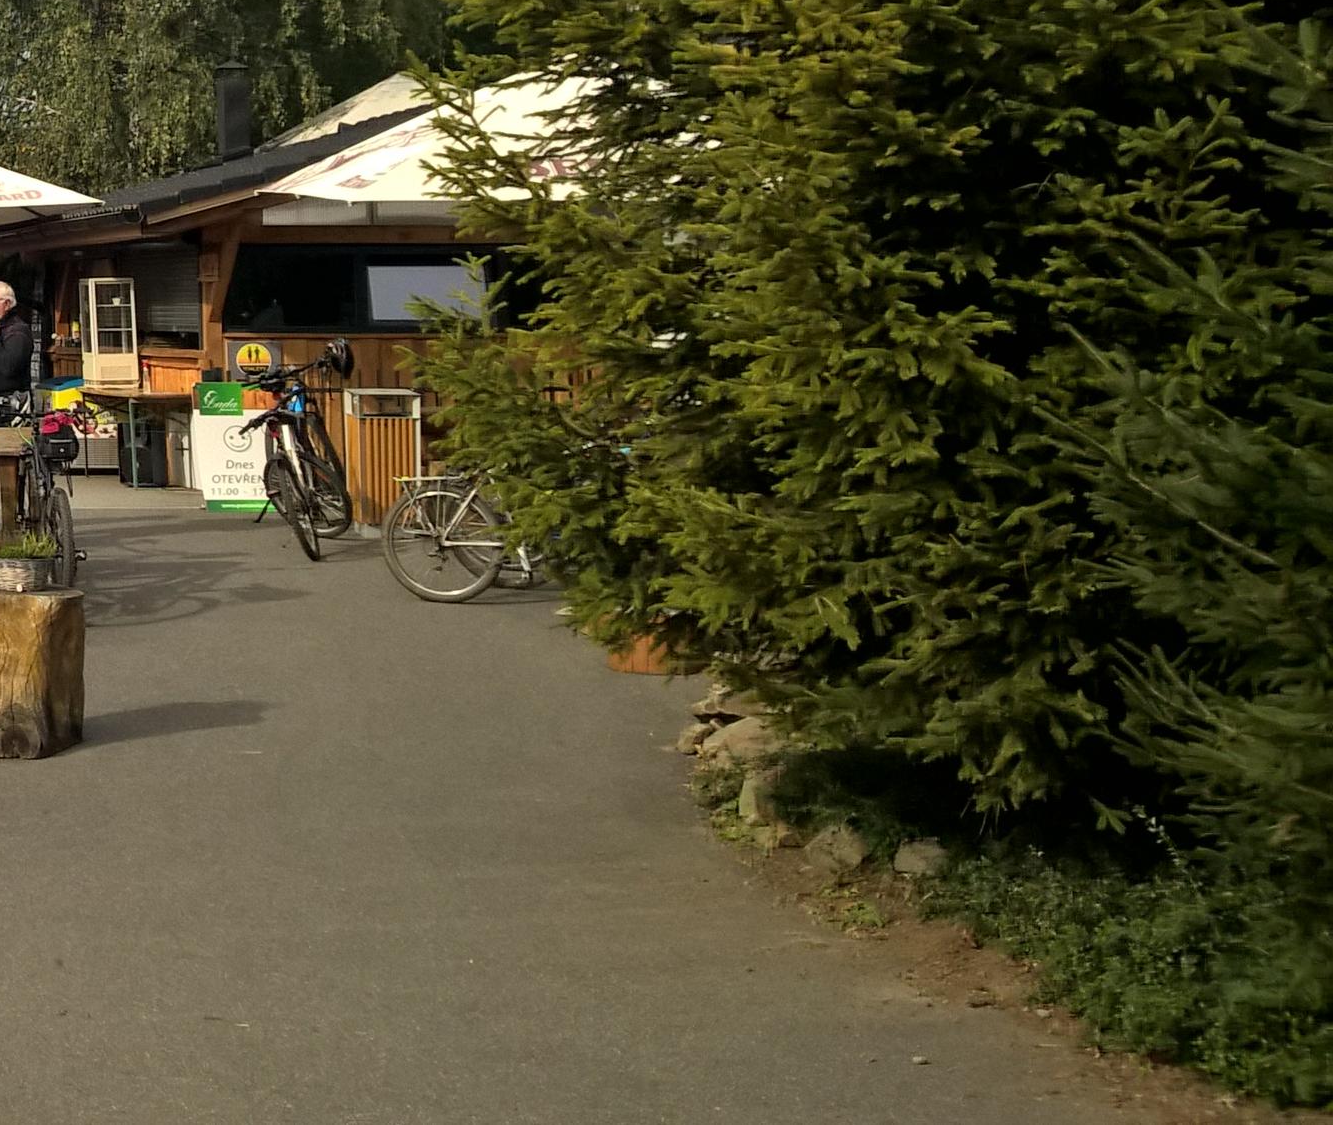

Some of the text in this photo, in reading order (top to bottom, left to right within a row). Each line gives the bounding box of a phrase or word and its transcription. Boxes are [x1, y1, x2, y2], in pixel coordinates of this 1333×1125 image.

[226, 459, 254, 469] Dnes
[211, 473, 264, 484] OTEVŘEN
[211, 487, 239, 496] 11.00
